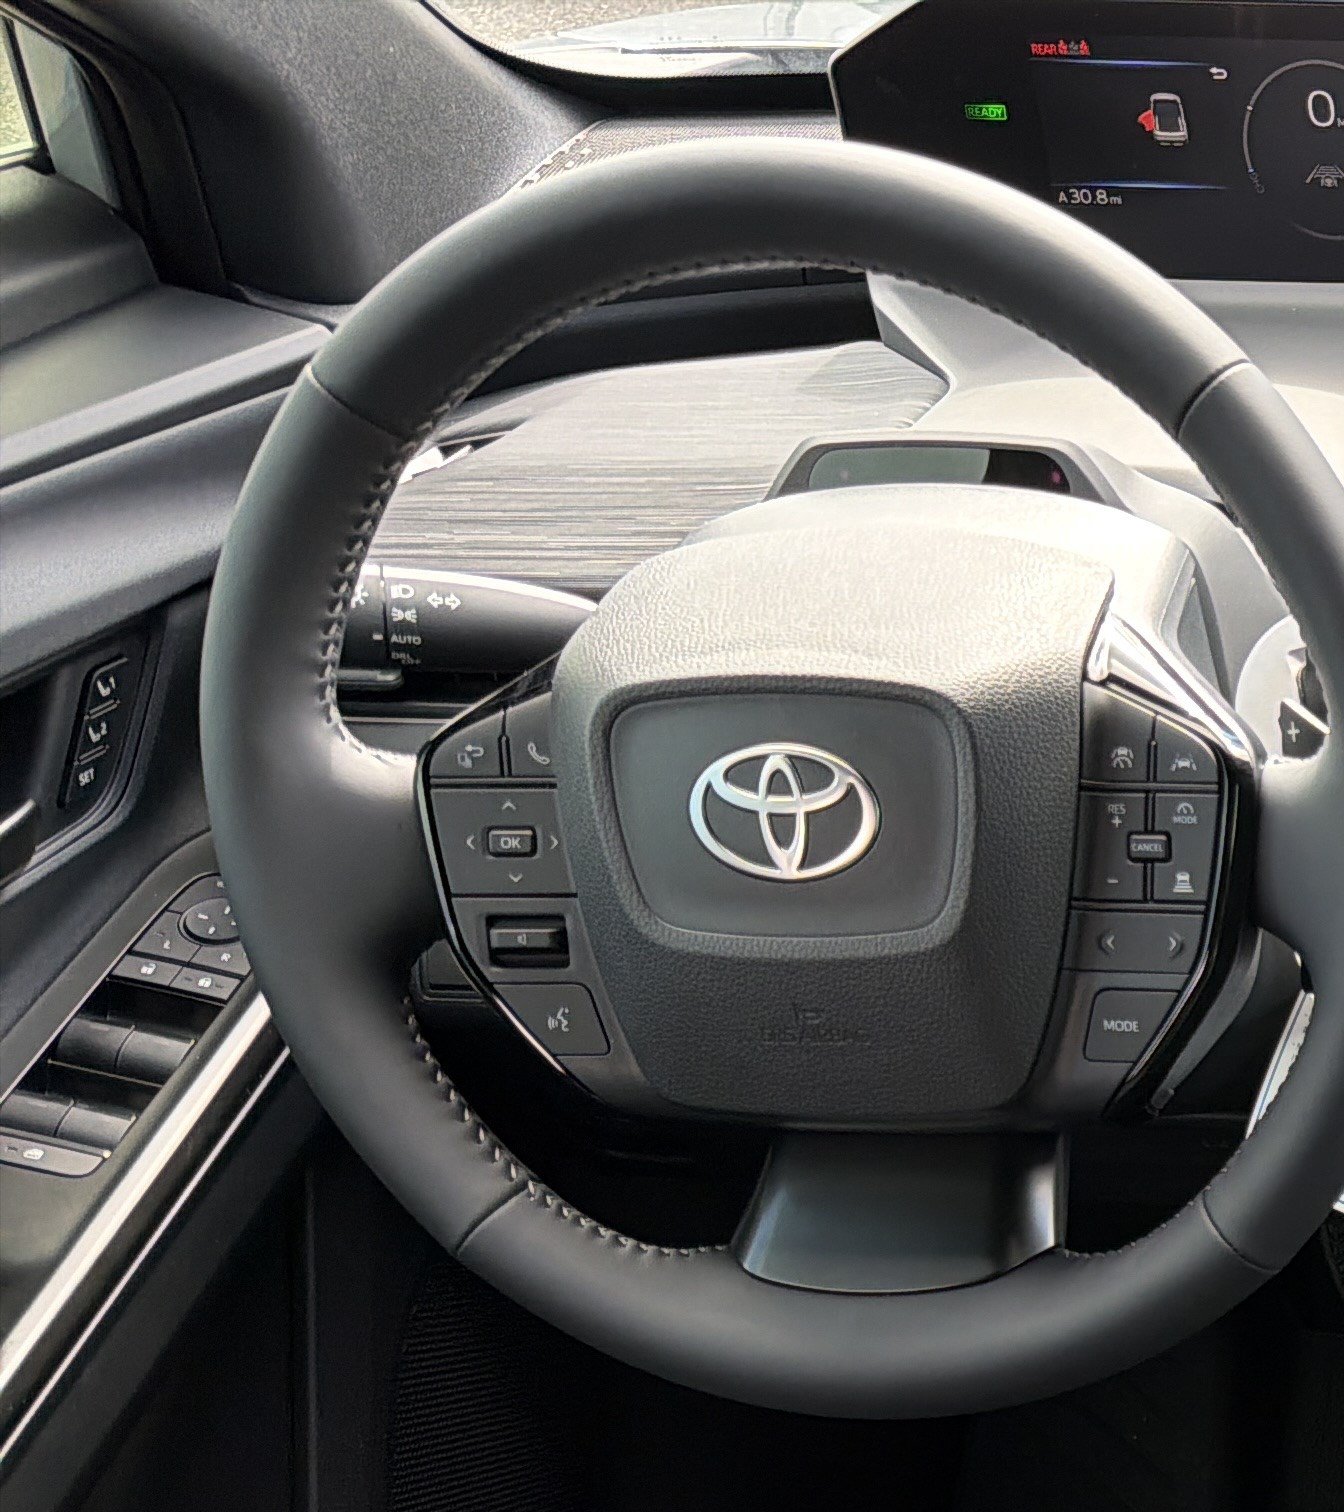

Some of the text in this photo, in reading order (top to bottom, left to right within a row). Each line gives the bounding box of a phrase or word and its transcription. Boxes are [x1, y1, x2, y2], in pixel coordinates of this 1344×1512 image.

[1030, 42, 1057, 55] REAR
[968, 106, 1004, 117] READY
[1306, 89, 1335, 127] 0
[390, 634, 422, 646] AUTO
[78, 767, 95, 787] SET
[1107, 804, 1126, 815] RES
[1173, 816, 1198, 825] MODE
[500, 837, 522, 849] OK
[1132, 843, 1164, 852] CANCEL
[1102, 1019, 1140, 1033] MODE
